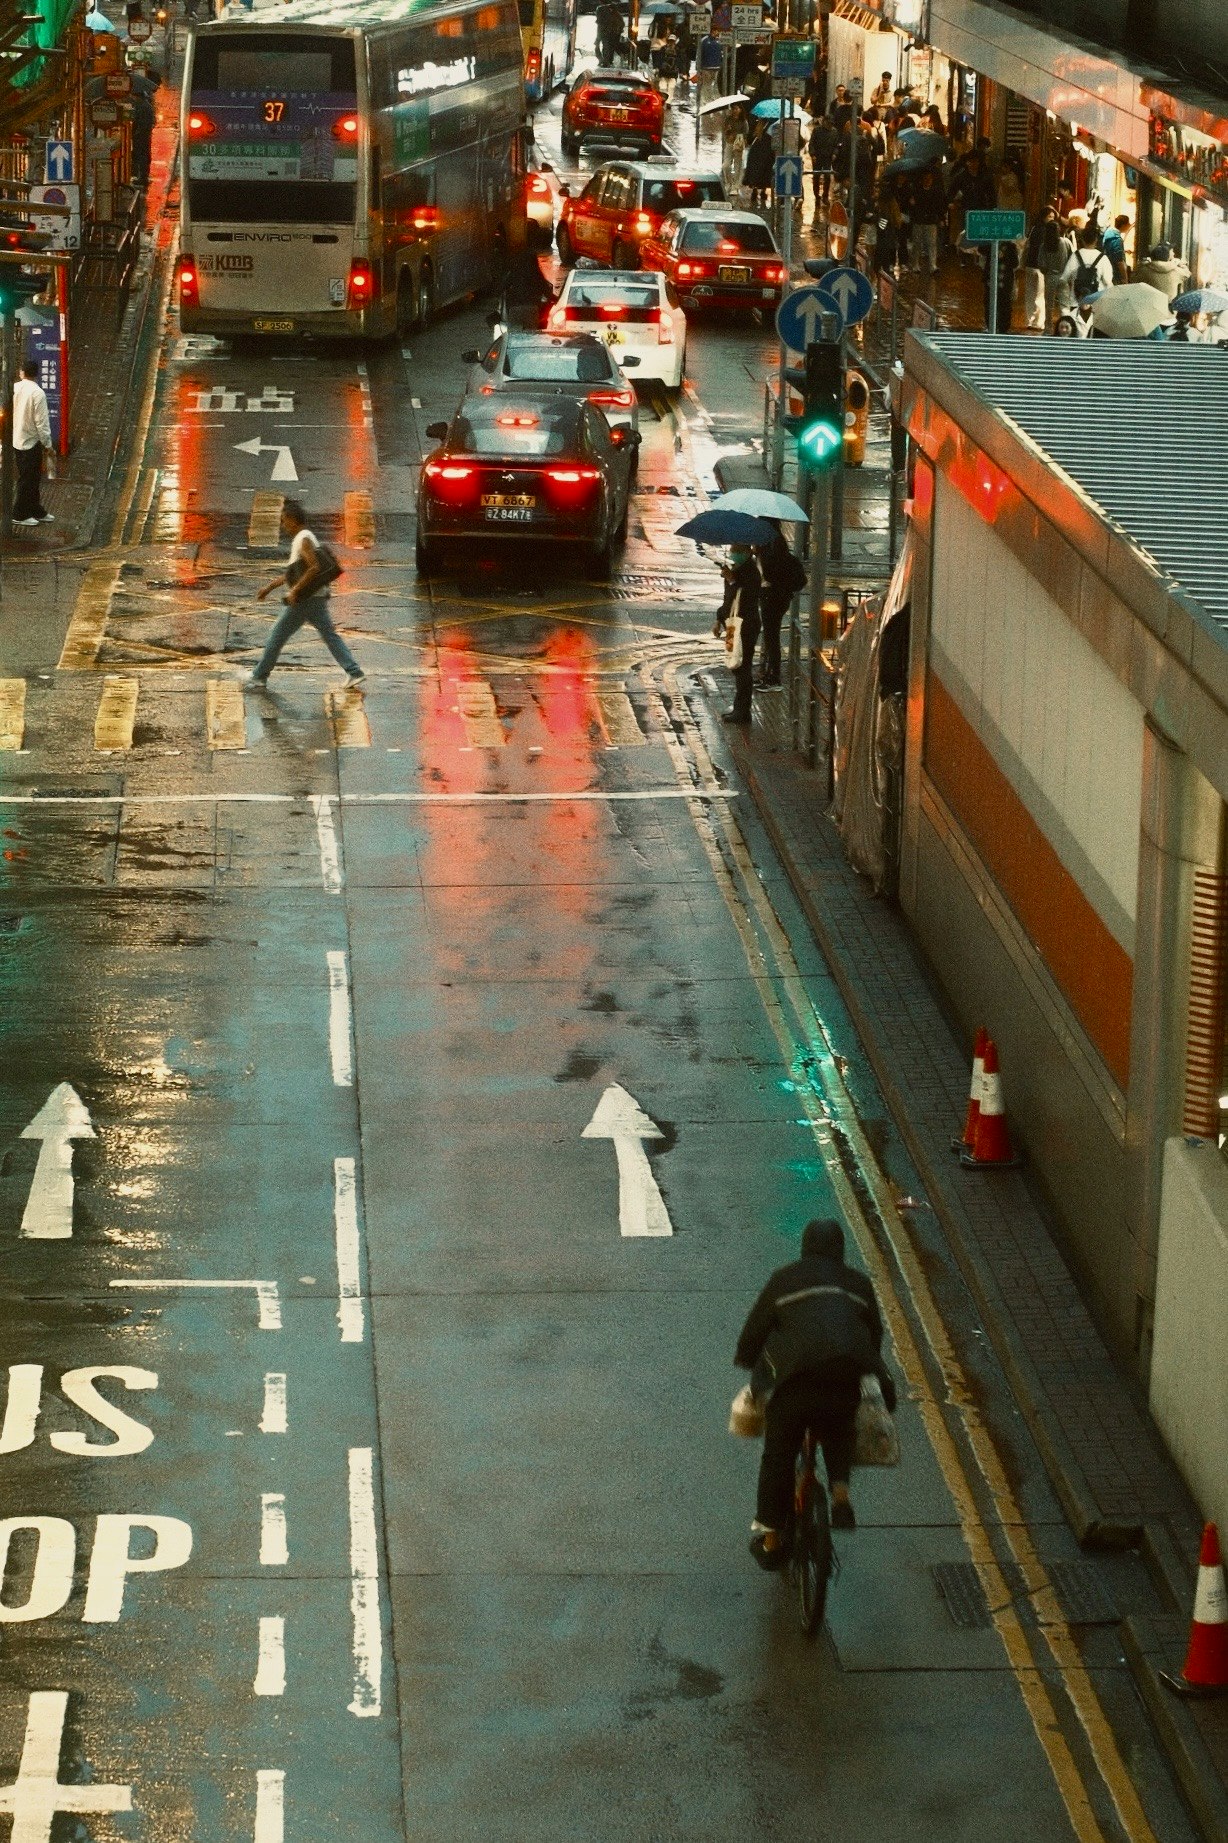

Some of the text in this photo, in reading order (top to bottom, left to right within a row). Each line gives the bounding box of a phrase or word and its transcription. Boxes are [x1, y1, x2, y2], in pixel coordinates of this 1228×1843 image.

[737, 15, 756, 25] 全日
[264, 102, 284, 122] 37
[63, 216, 71, 228] 7
[64, 236, 79, 248] 12
[484, 496, 533, 506] VT 6867
